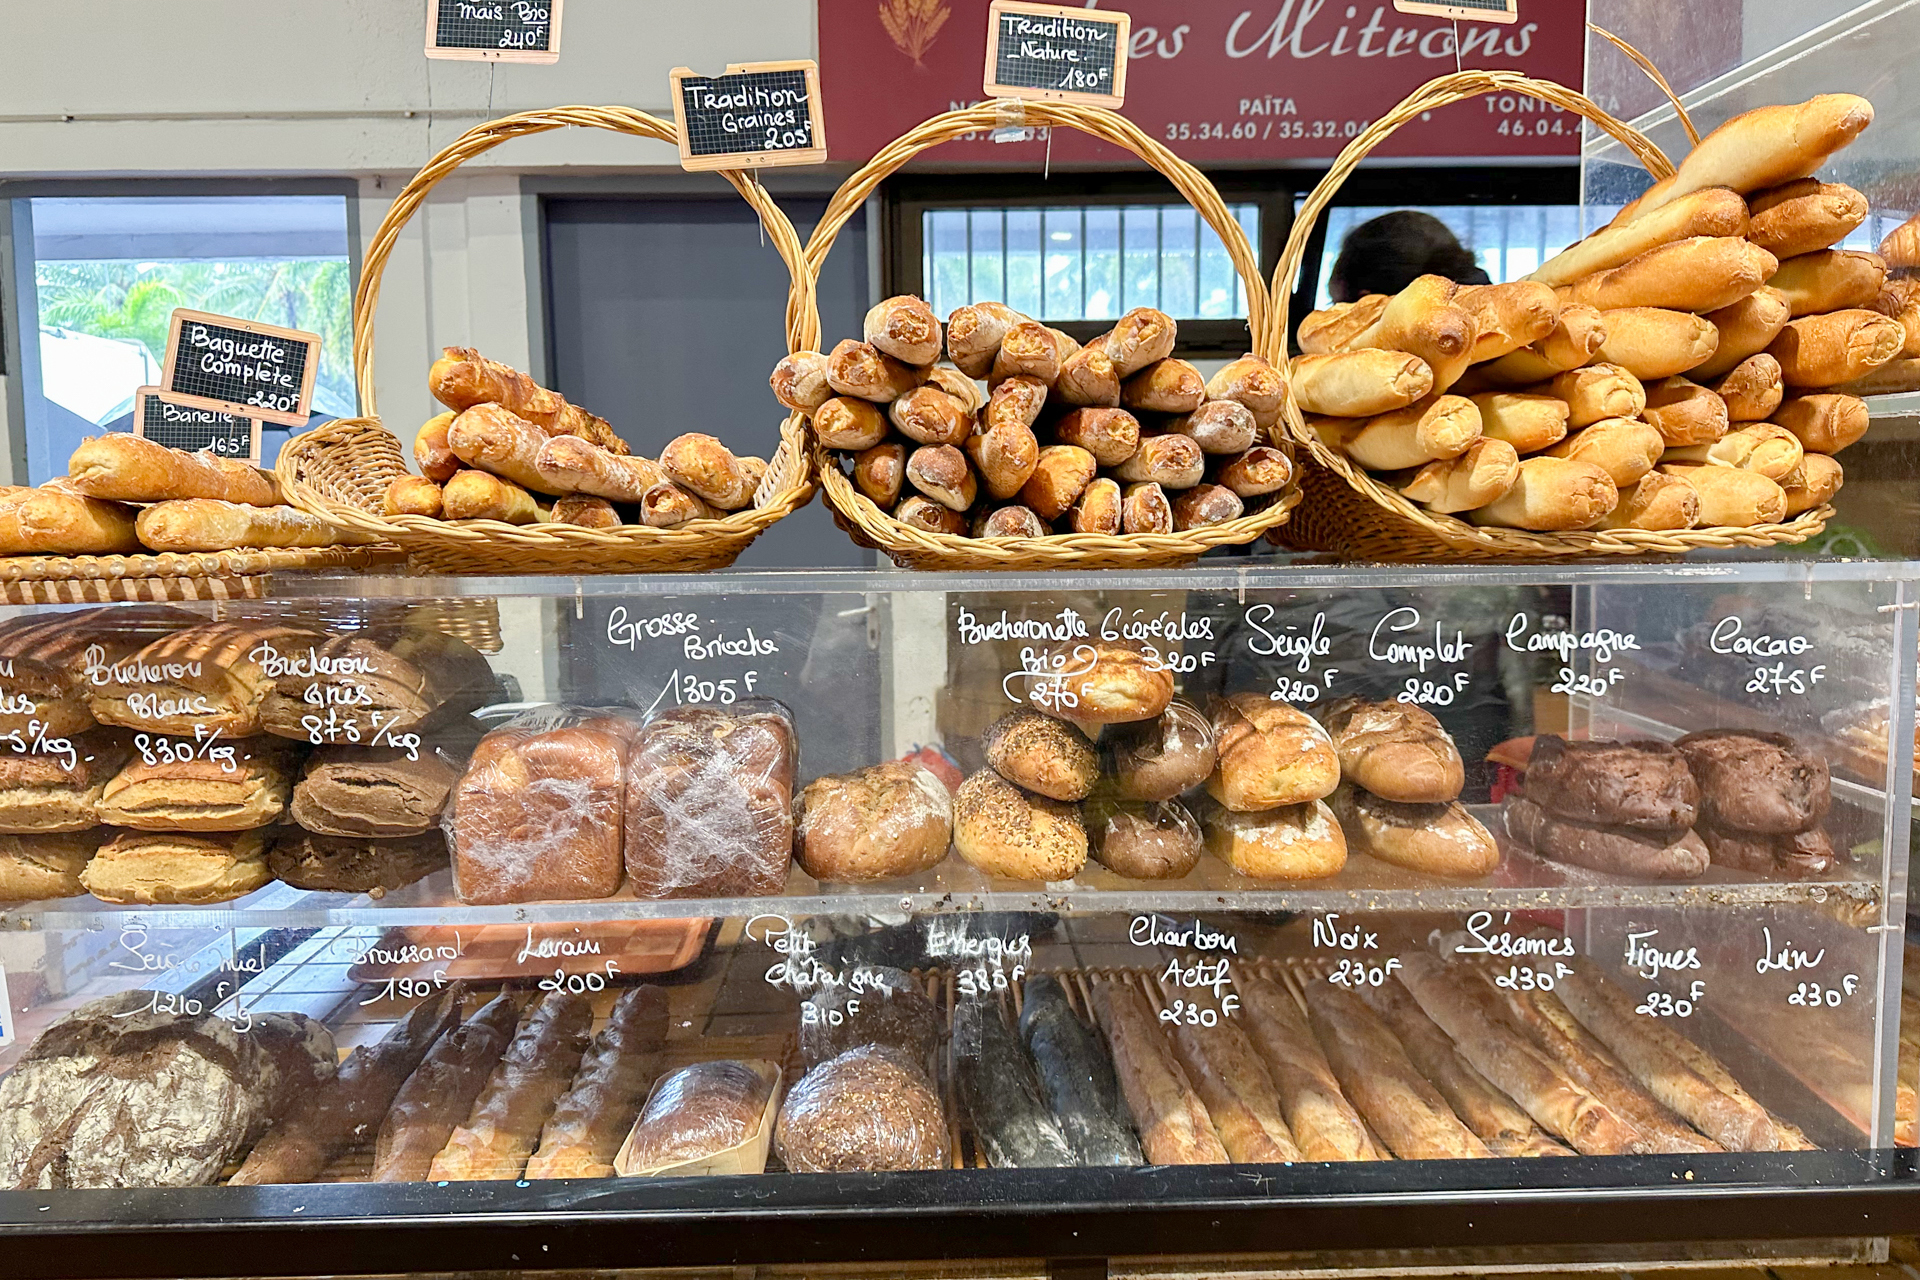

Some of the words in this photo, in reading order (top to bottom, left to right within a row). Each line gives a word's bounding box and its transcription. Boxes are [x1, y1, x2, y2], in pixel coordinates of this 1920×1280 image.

[510, 1, 549, 24] Bio
[1000, 16, 1108, 41] Tradition
[1225, 0, 1538, 59] Mitrons
[683, 84, 810, 110] Tradition
[1239, 95, 1298, 116] PAÏTA
[1485, 94, 1620, 113] TONTOTA
[722, 110, 796, 133] Graines
[1165, 121, 1257, 141] 35.34.60
[190, 325, 285, 364] Baguette
[200, 353, 295, 388] Complète
[607, 606, 700, 651] Grosse
[683, 627, 780, 660] Brioche
[1245, 603, 1331, 673] Seigle
[1369, 606, 1474, 673] Complet
[1504, 612, 1642, 663] Campagne
[1709, 615, 1814, 657] Cacao
[1019, 646, 1067, 673] Bio
[127, 692, 217, 719] Blanc
[330, 930, 462, 965] Broussard
[517, 926, 601, 964] Levain
[1129, 915, 1238, 954] Charbon
[1313, 913, 1379, 949] Noix
[1454, 911, 1576, 958] Sésames
[1624, 929, 1702, 979] Figues
[1756, 926, 1826, 974] Lin
[1160, 957, 1232, 998] Actif
